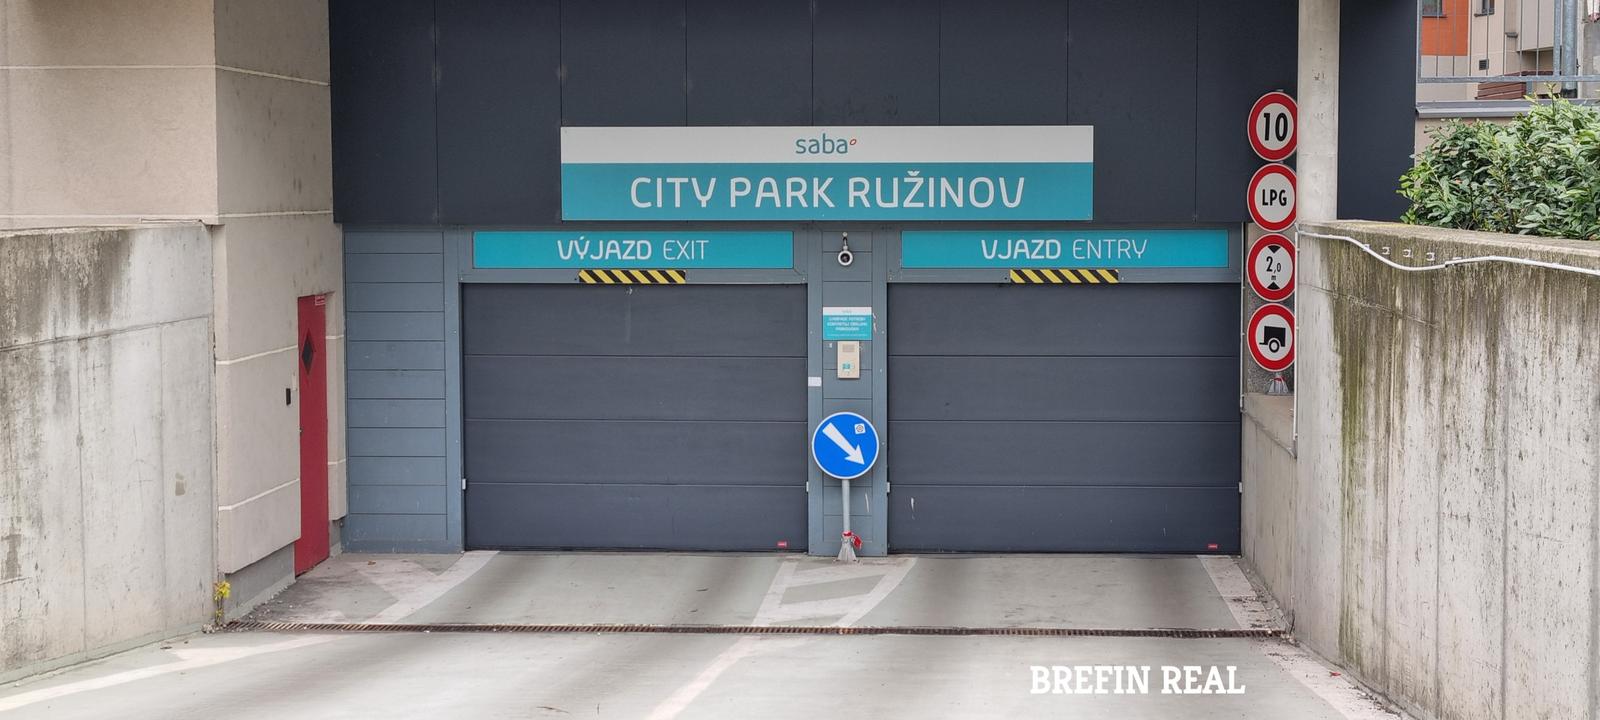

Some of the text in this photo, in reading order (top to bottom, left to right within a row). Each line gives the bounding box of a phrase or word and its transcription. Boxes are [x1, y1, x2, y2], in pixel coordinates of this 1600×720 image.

[1263, 112, 1288, 142] 10
[795, 133, 849, 154] saba
[629, 169, 1025, 209] CITY PARK RUŽINOV
[1262, 189, 1287, 207] LPG
[557, 235, 709, 261] VÝJAZD EXIT
[981, 239, 1148, 260] VJAZD ENTRY
[1266, 256, 1281, 274] 2,0
